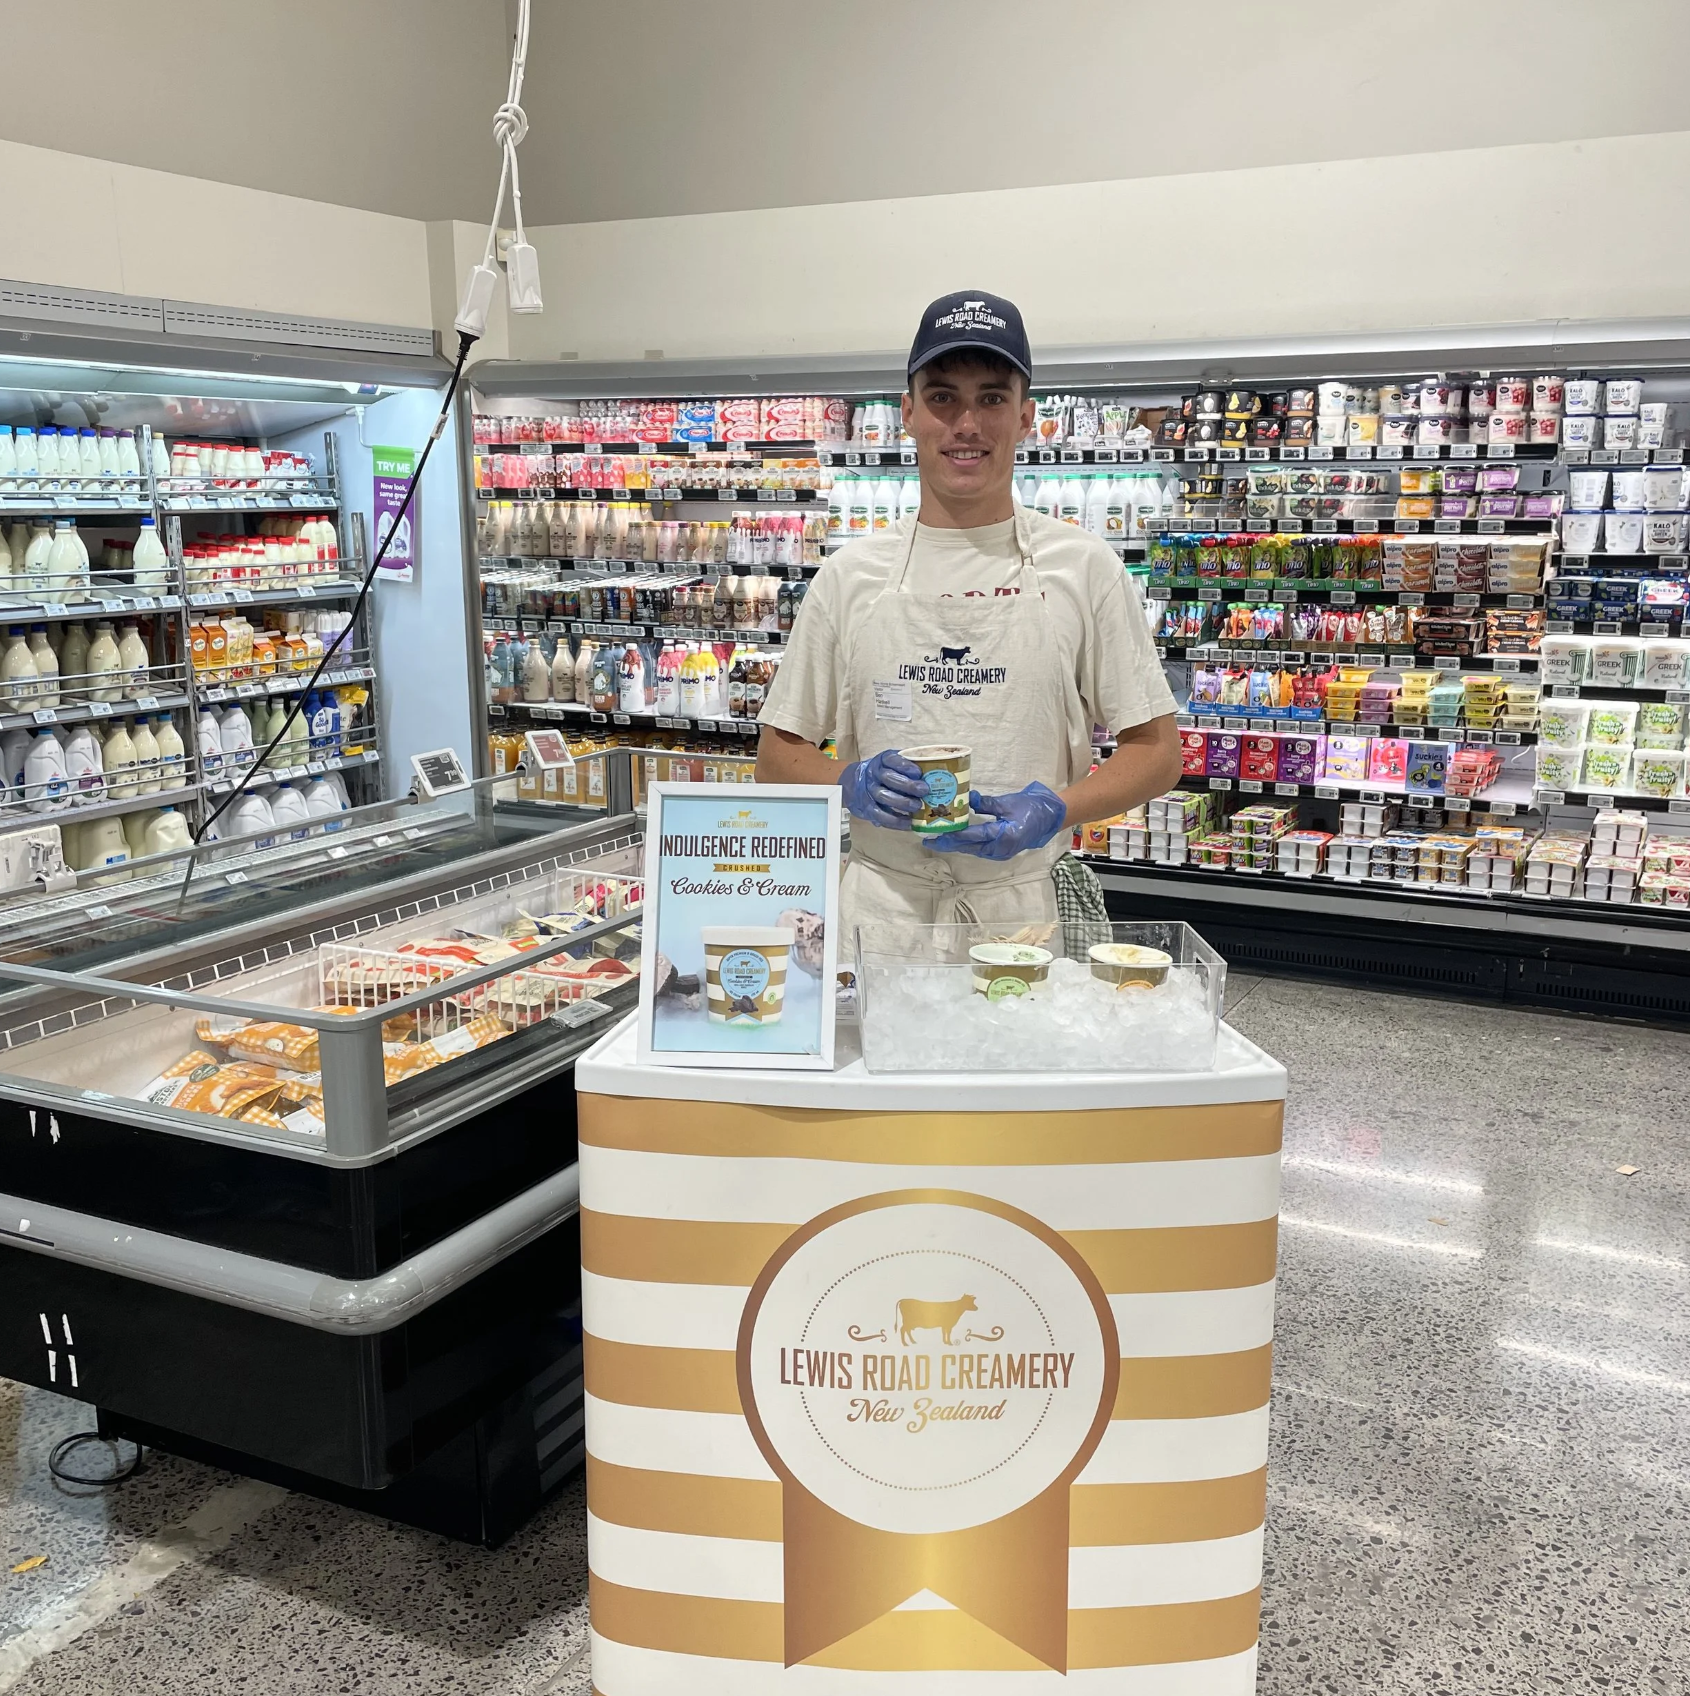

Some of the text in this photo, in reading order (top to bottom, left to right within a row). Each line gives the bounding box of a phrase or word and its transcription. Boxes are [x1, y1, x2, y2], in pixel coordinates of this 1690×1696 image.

[935, 312, 1006, 329] LEWIS ROAD CREAMERY
[377, 461, 410, 473] TRY ME
[394, 483, 407, 492] look,
[899, 664, 1006, 684] LEWIS ROAD CREAMERY
[922, 684, 981, 699] New Zealand
[1415, 753, 1443, 761] suckies
[660, 835, 826, 859] INDULGENCE REDEFINED
[671, 877, 812, 896] Cookies & Cream
[780, 1347, 1075, 1391] LEWIS ROAD CREAMERY
[847, 1397, 1008, 1433] New Zealand
